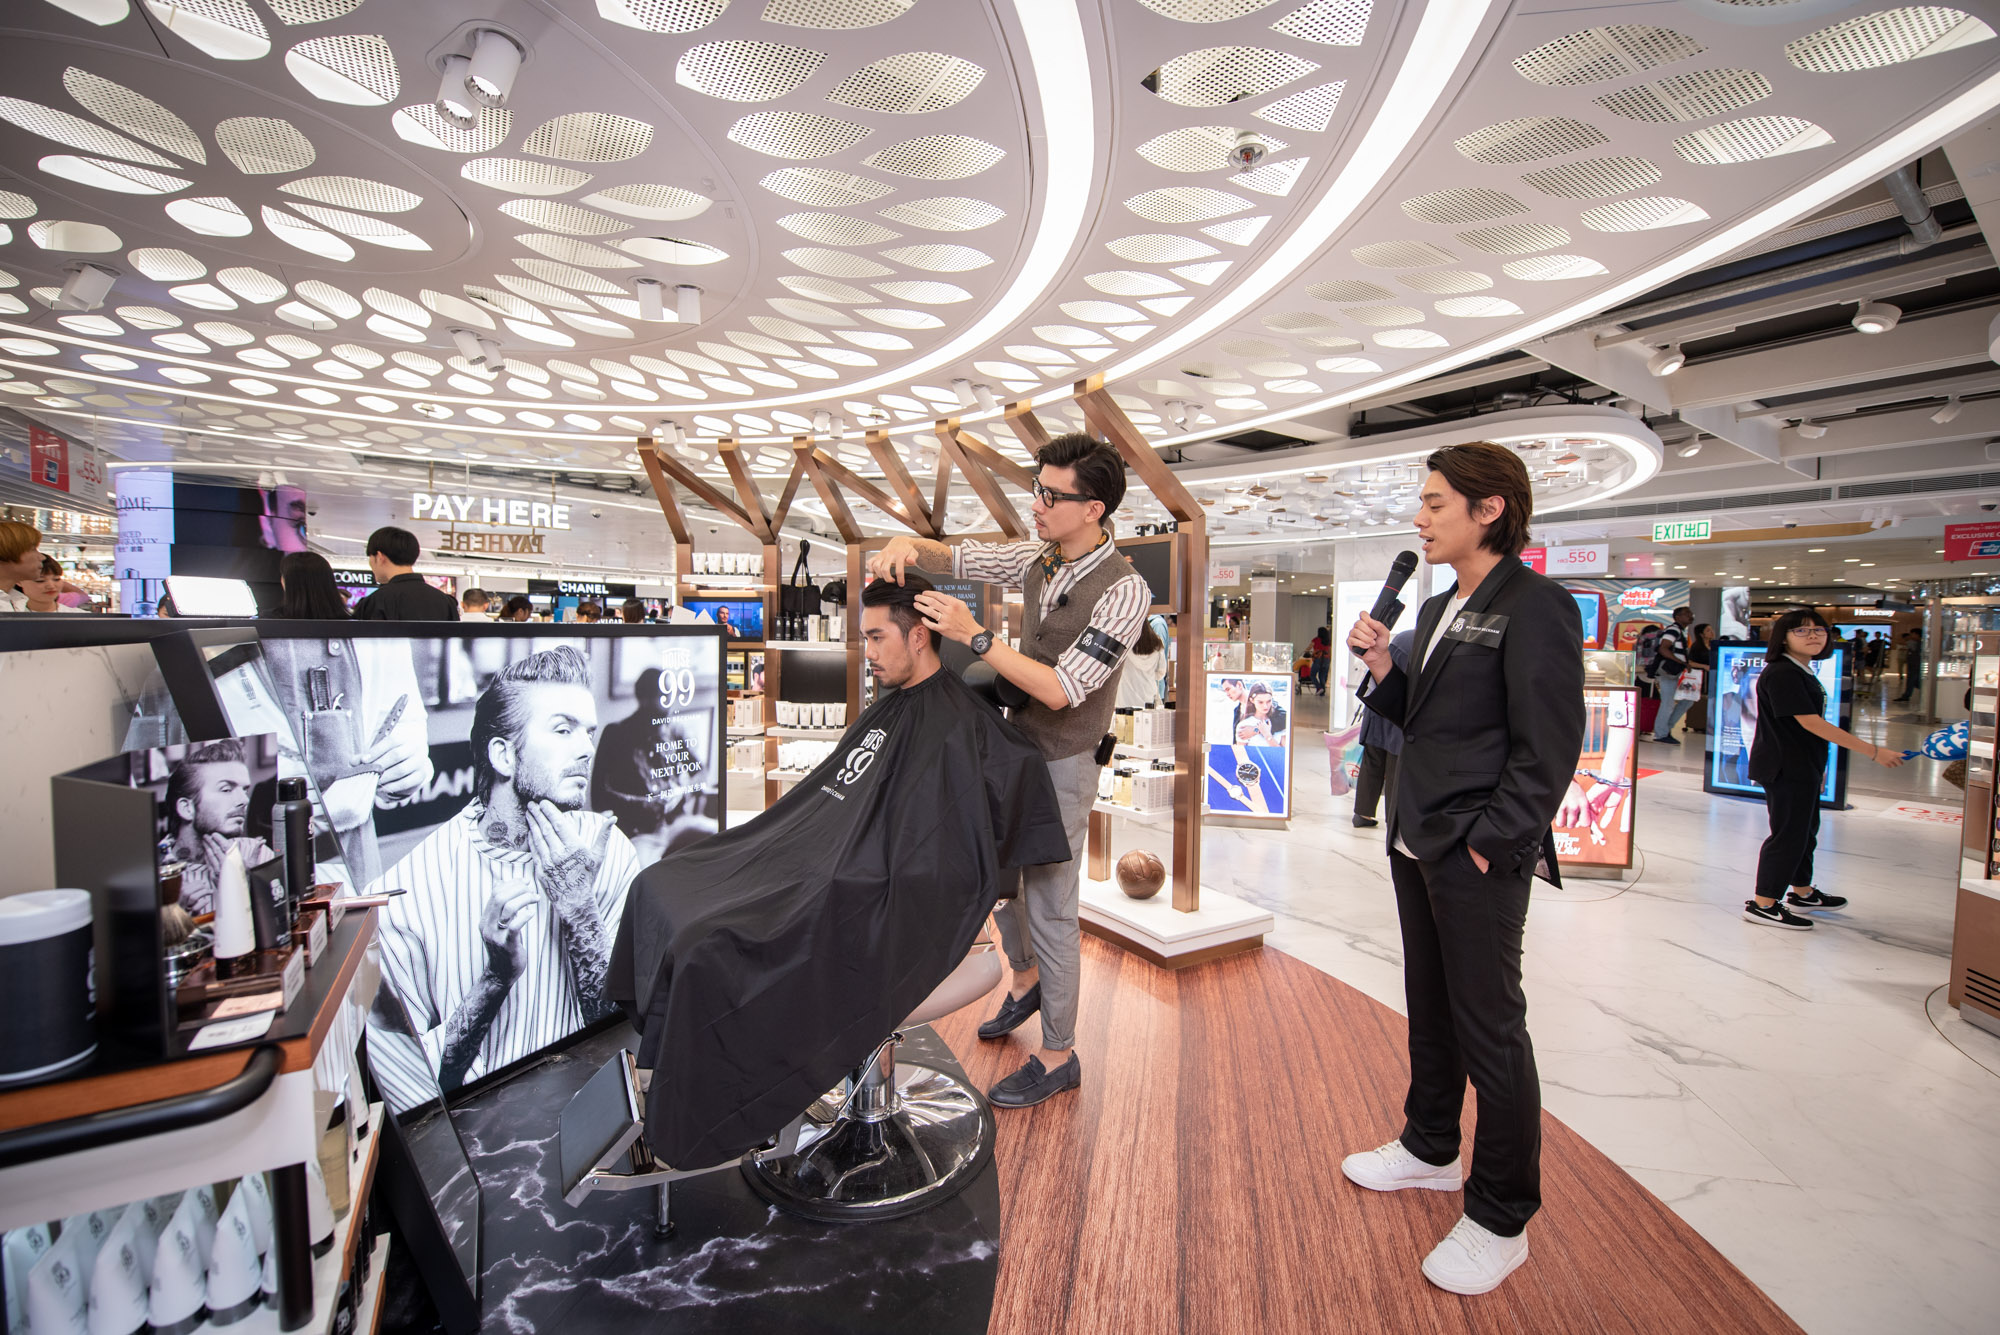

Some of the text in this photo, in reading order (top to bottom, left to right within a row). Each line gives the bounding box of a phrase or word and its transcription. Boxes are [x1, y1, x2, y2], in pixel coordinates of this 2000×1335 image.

[412, 492, 570, 530] PAY HERE
[1655, 521, 1709, 540] EXIT 出口
[1951, 532, 1994, 540] EXCLUSIVE
[559, 582, 610, 594] CHANEL
[1623, 590, 1654, 598] SWEET
[1854, 608, 1896, 617] Hennessy
[662, 651, 691, 670] HOUSE
[658, 668, 696, 709] 99
[652, 717, 671, 726] DAVID
[656, 737, 698, 753] HOME TO
[665, 751, 690, 764] YOUR
[651, 761, 702, 779] NEXT LOOK
